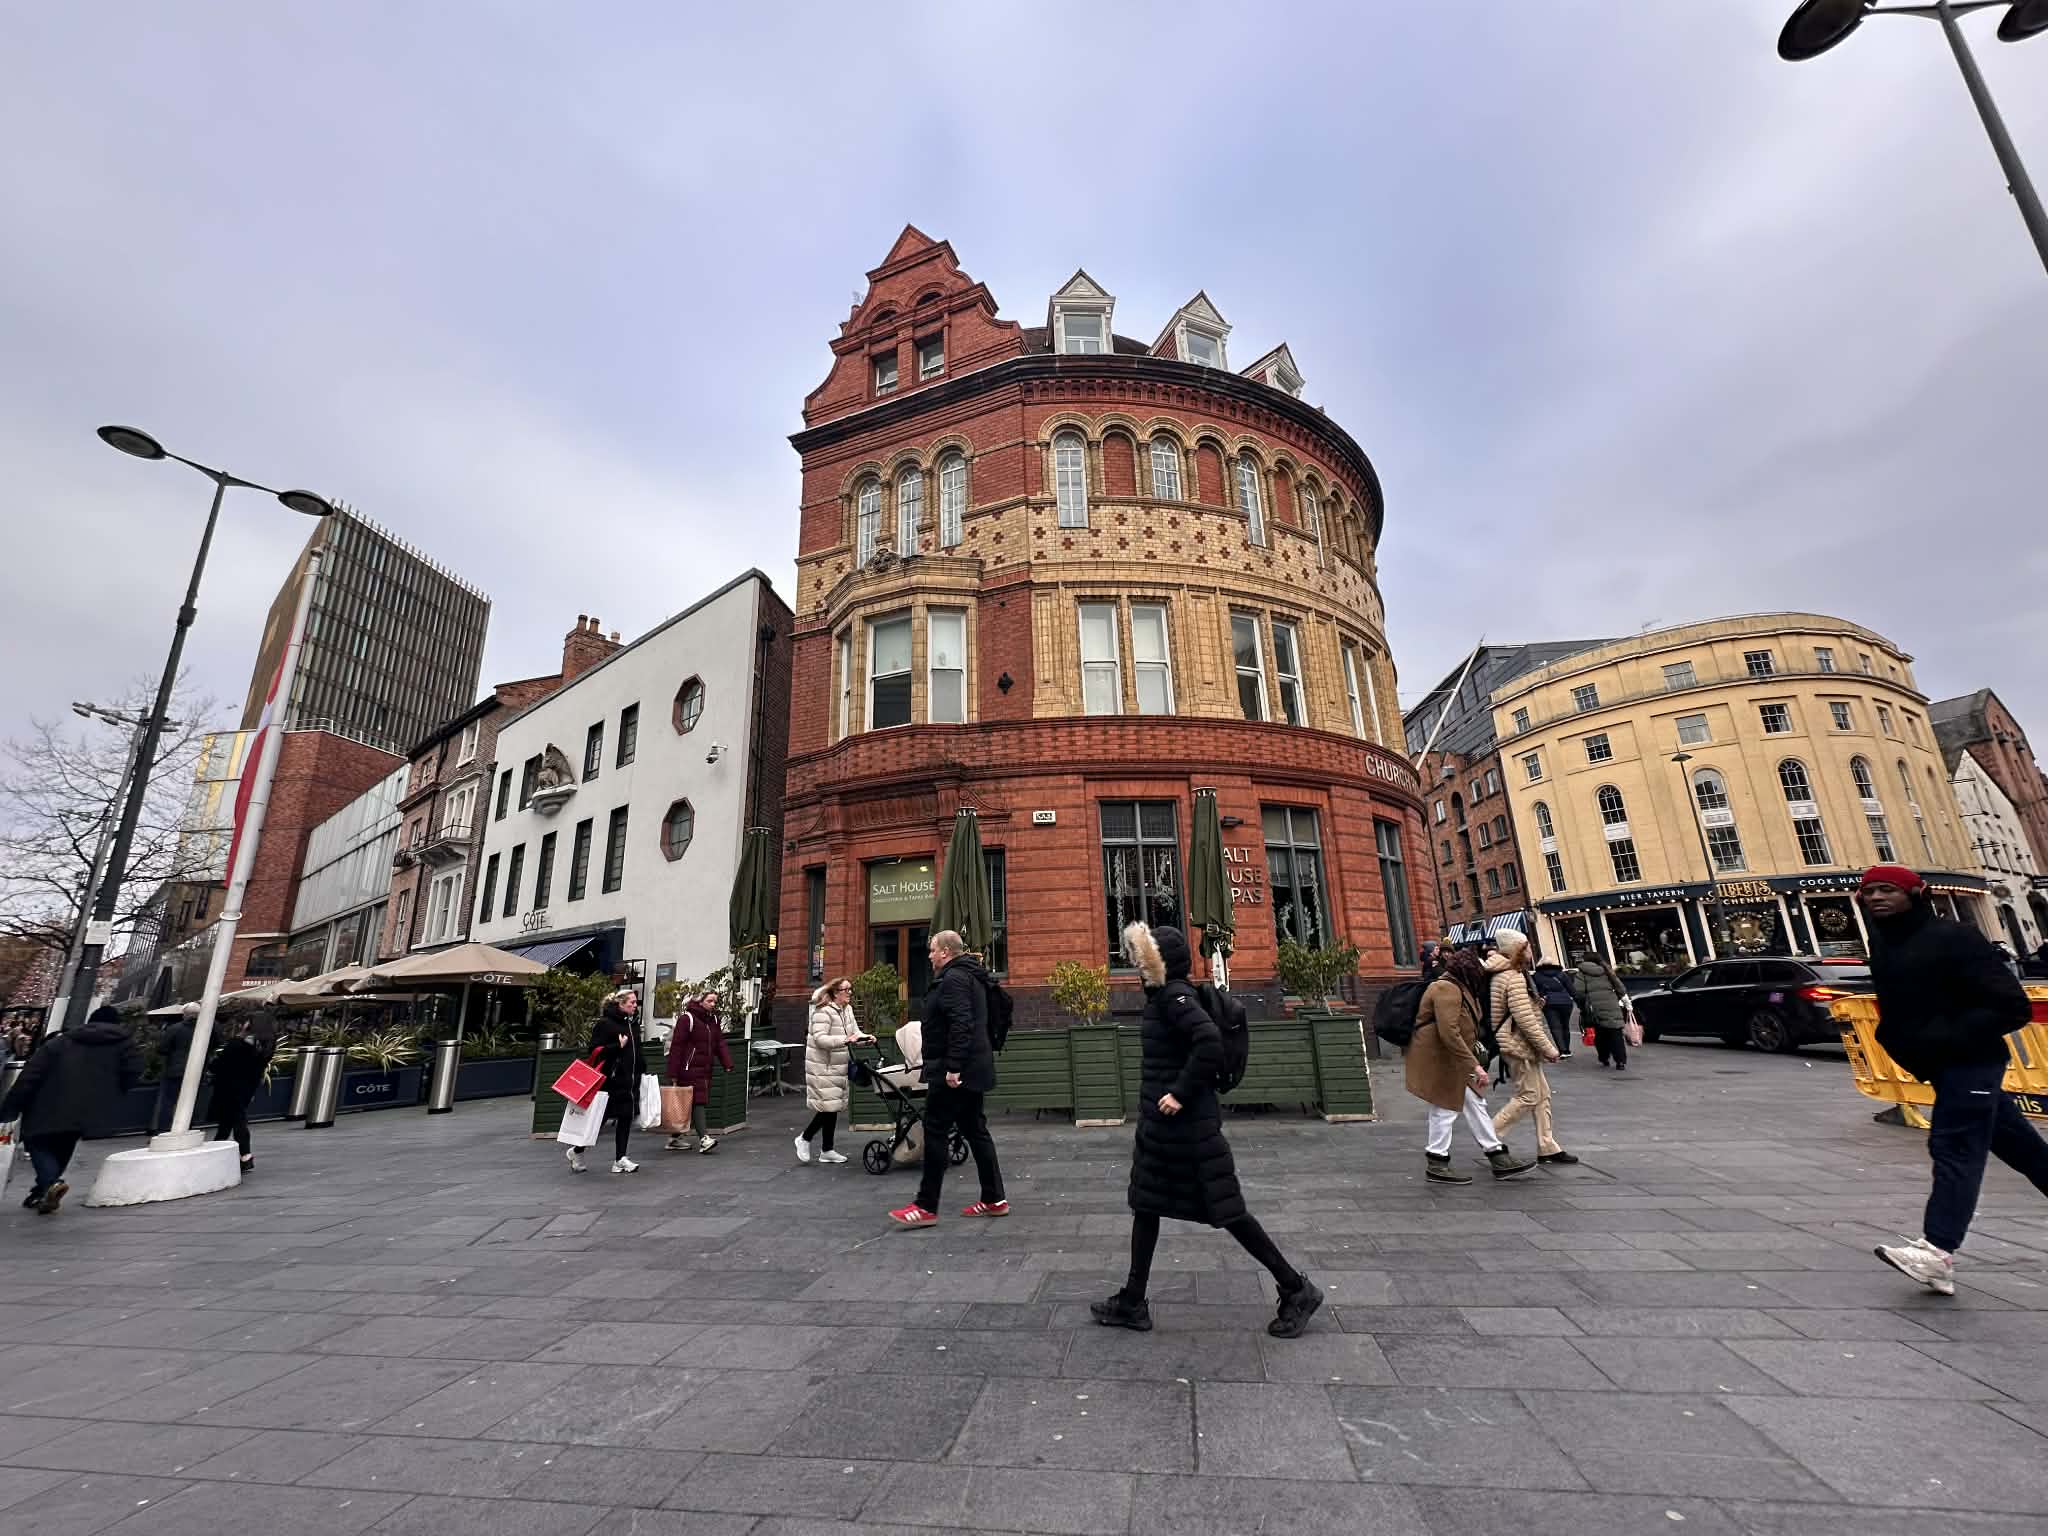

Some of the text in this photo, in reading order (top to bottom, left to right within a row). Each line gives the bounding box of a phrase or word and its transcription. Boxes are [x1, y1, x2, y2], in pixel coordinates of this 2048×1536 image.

[1223, 847, 1252, 863] ALT
[1226, 867, 1263, 884] USE
[1799, 876, 1863, 887] COOK HAU
[873, 881, 935, 896] SALT HOUSE
[1231, 887, 1264, 903] PAS
[1620, 889, 1685, 901] BIER TAVERN
[356, 1083, 392, 1095] CÔTE
